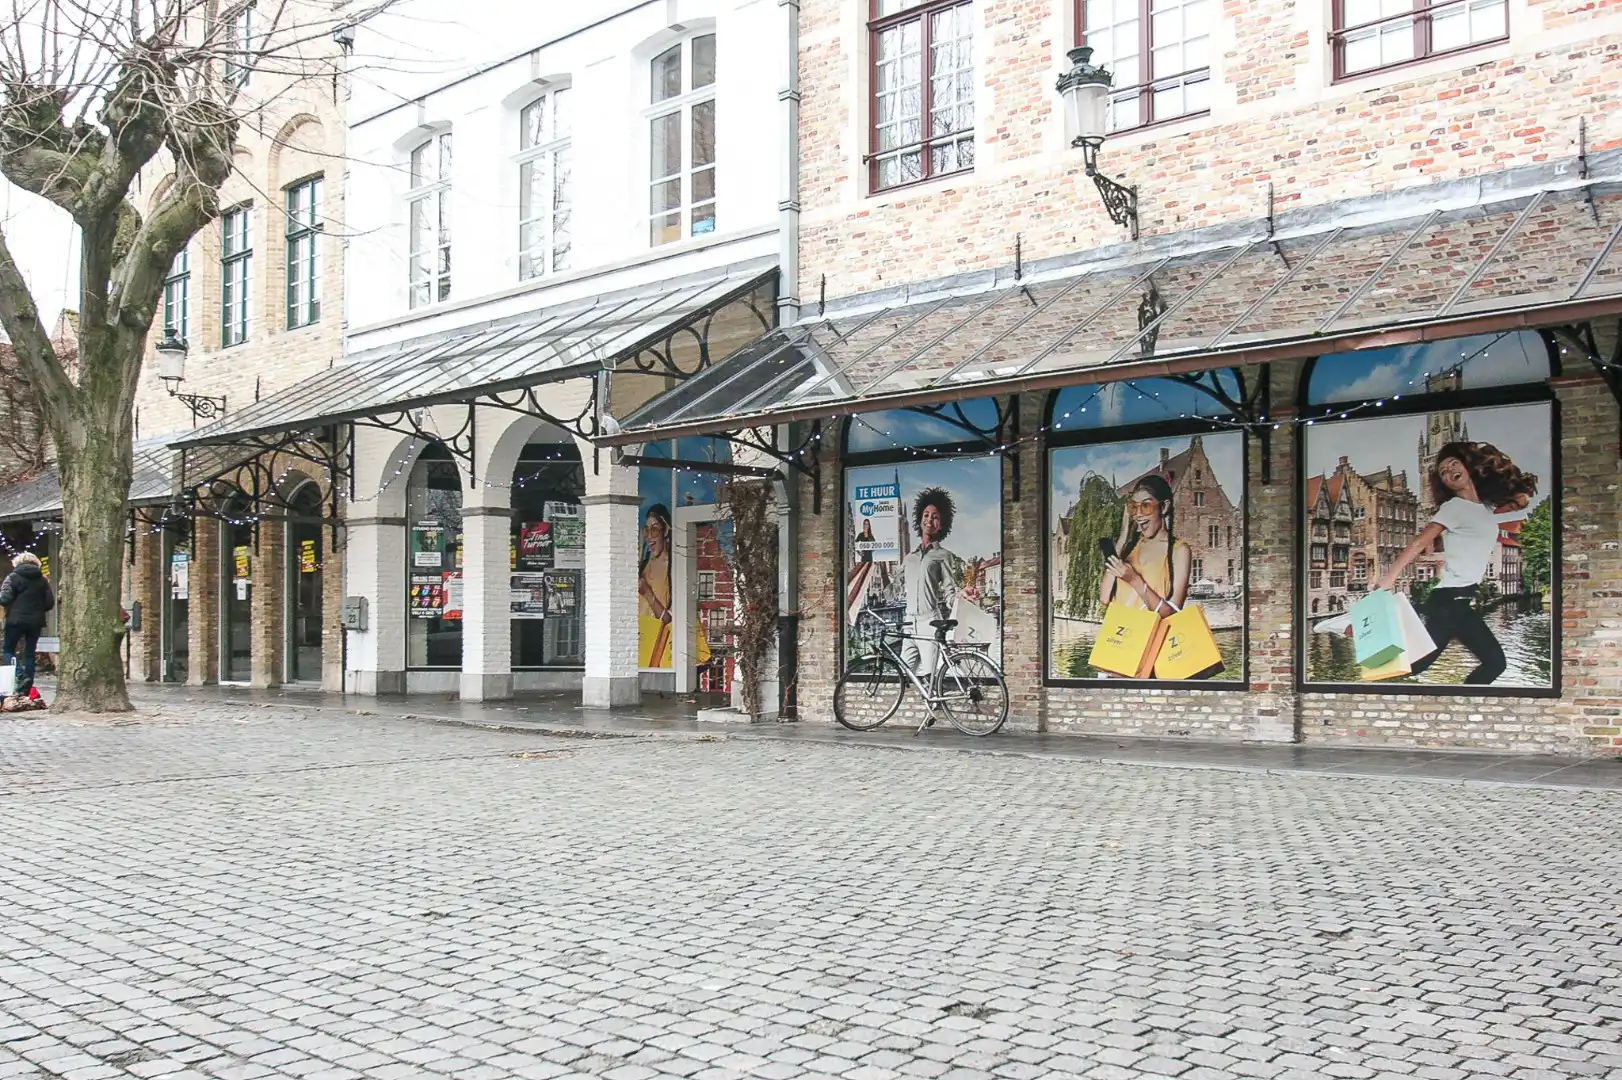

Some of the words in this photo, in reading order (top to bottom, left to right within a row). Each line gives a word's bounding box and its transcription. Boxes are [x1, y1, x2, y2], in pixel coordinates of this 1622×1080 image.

[859, 487, 868, 498] TE
[870, 486, 895, 497] HUUR
[530, 531, 550, 541] Tina
[523, 539, 553, 549] Turner
[544, 575, 576, 584] QUEEN
